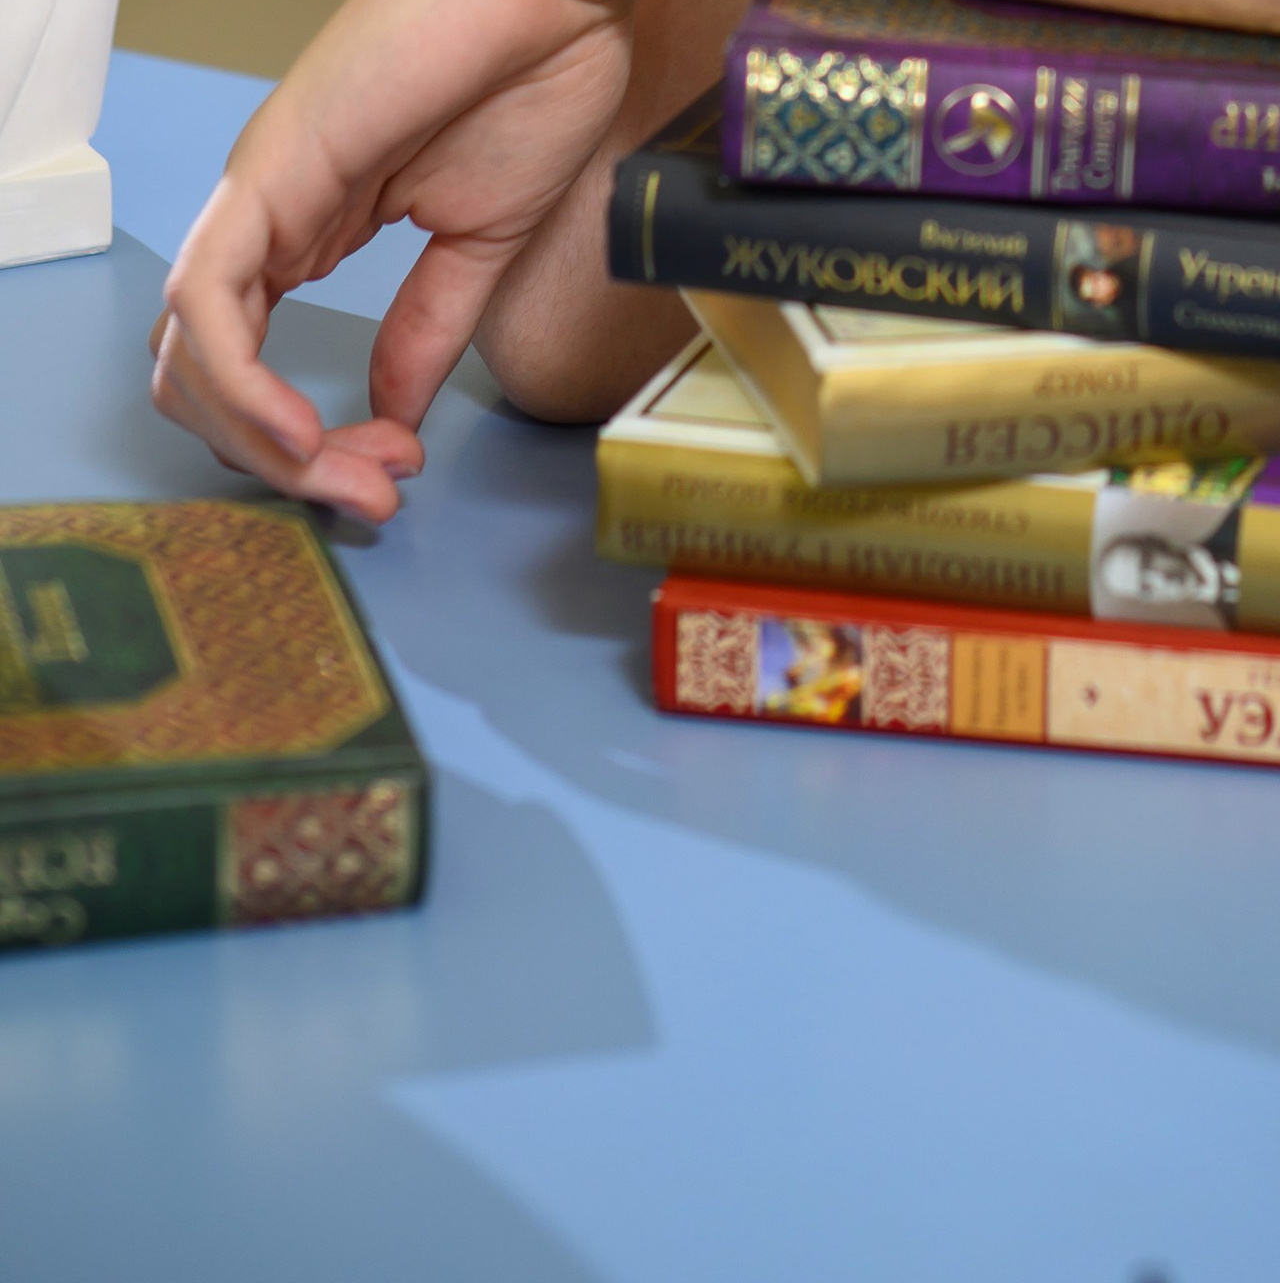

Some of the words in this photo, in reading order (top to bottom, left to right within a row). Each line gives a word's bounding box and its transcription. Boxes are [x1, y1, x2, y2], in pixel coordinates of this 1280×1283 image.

[722, 234, 1026, 313] ЖУКОВСКИЙ
[1034, 362, 1140, 401] ГОМЕР
[944, 400, 1232, 470] ОДИССЕЯ
[847, 543, 1068, 602] НИКОЛАЙ
